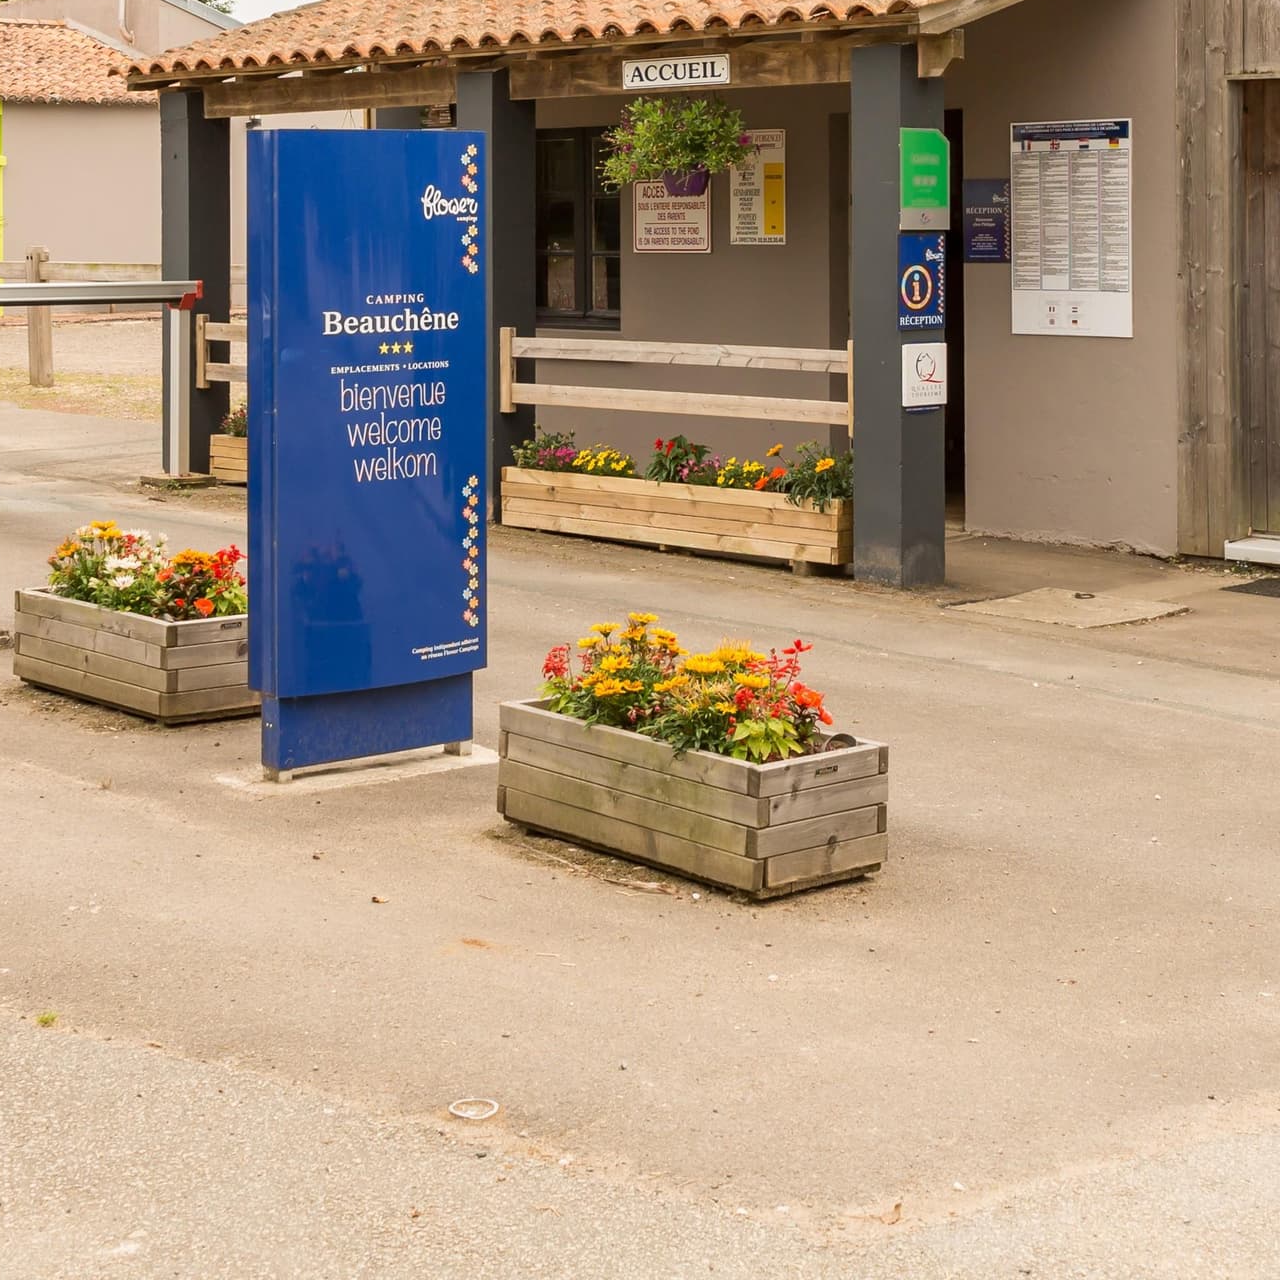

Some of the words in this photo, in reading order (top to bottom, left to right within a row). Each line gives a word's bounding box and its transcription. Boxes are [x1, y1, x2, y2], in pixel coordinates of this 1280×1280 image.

[630, 61, 722, 82] ACCUEIL
[421, 184, 478, 220] flower
[966, 206, 1002, 214] RÉCEPTION
[366, 293, 424, 304] CAMPING
[322, 306, 459, 335] Beauchêne
[900, 314, 943, 326] RÉCEPTION
[330, 364, 400, 375] EMPLACEMENTS
[408, 360, 450, 370] LOCATIONS
[341, 378, 446, 412] bienvenue
[347, 412, 442, 448] welcome
[354, 446, 437, 482] welkom
